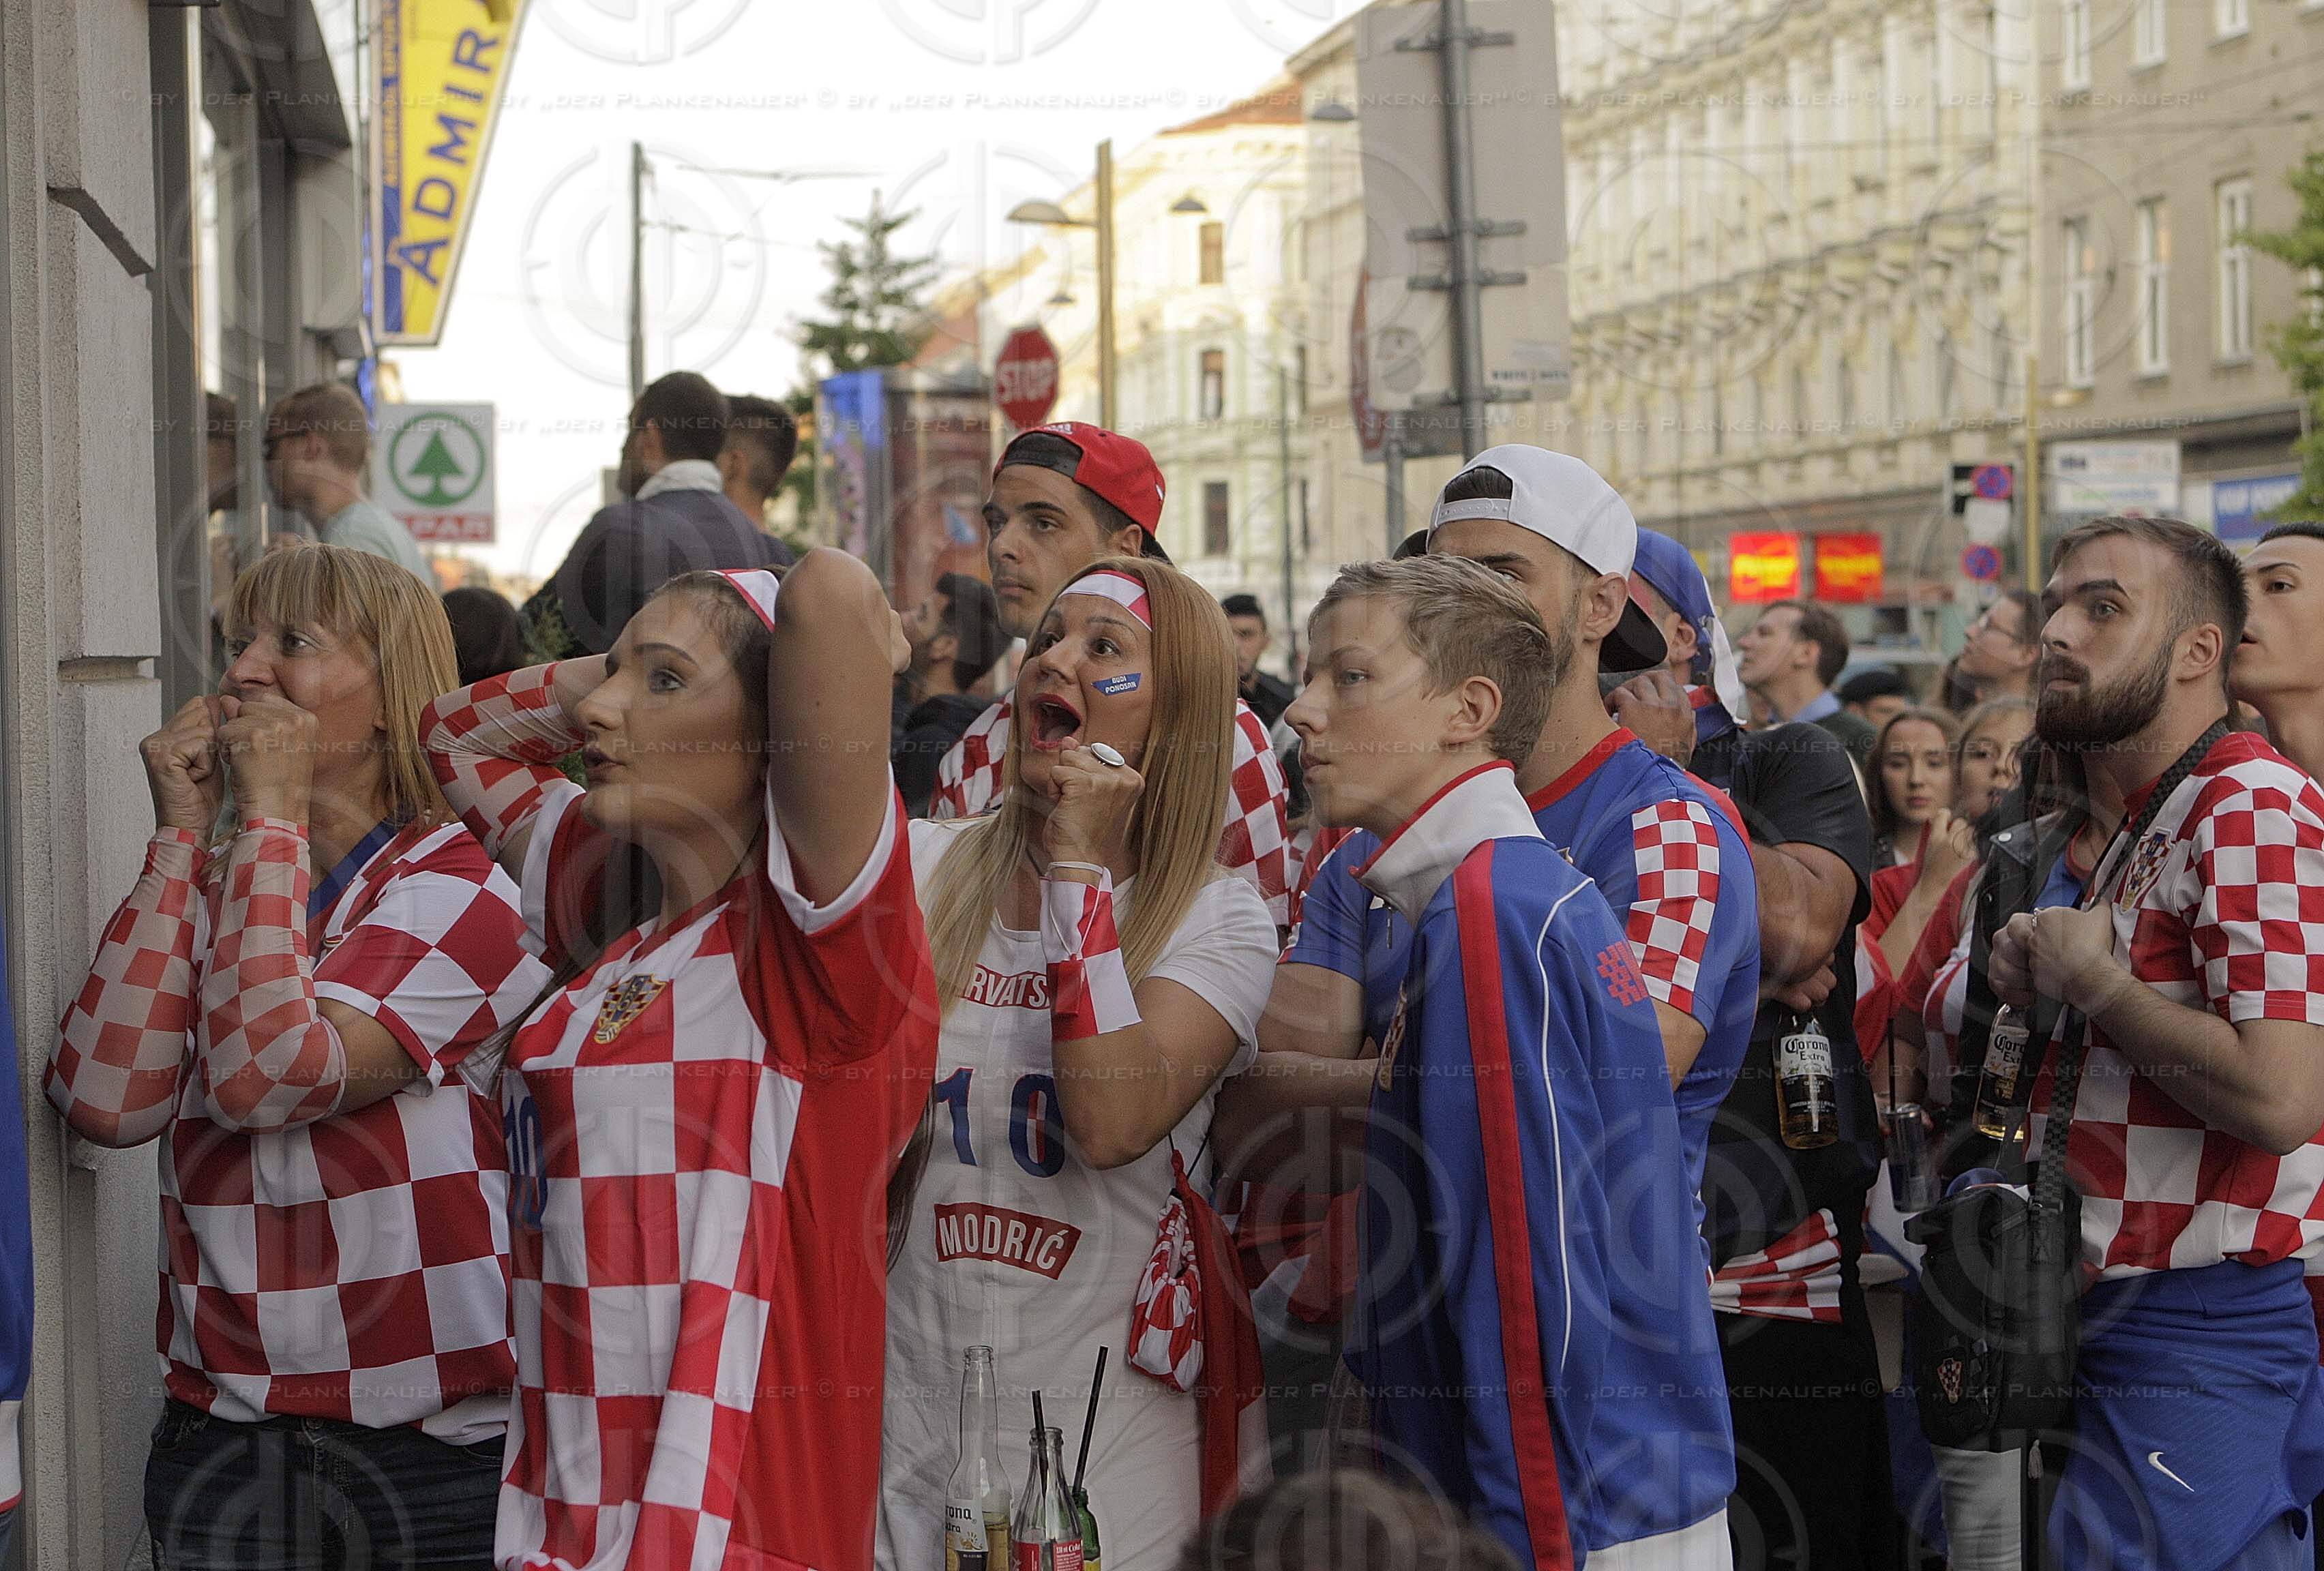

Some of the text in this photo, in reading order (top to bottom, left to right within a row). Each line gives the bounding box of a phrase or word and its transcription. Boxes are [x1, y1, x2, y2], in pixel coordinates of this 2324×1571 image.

[398, 0, 498, 286] ADMIR
[997, 358, 1055, 402] STOP
[398, 516, 490, 539] PAR
[964, 966, 1051, 1008] RVATS
[1785, 1038, 1829, 1055] Corona
[1800, 1051, 1825, 1062] Extra
[935, 1067, 1065, 1178] 10
[503, 1095, 548, 1231] 10
[938, 1213, 1069, 1270] MODRIĆ
